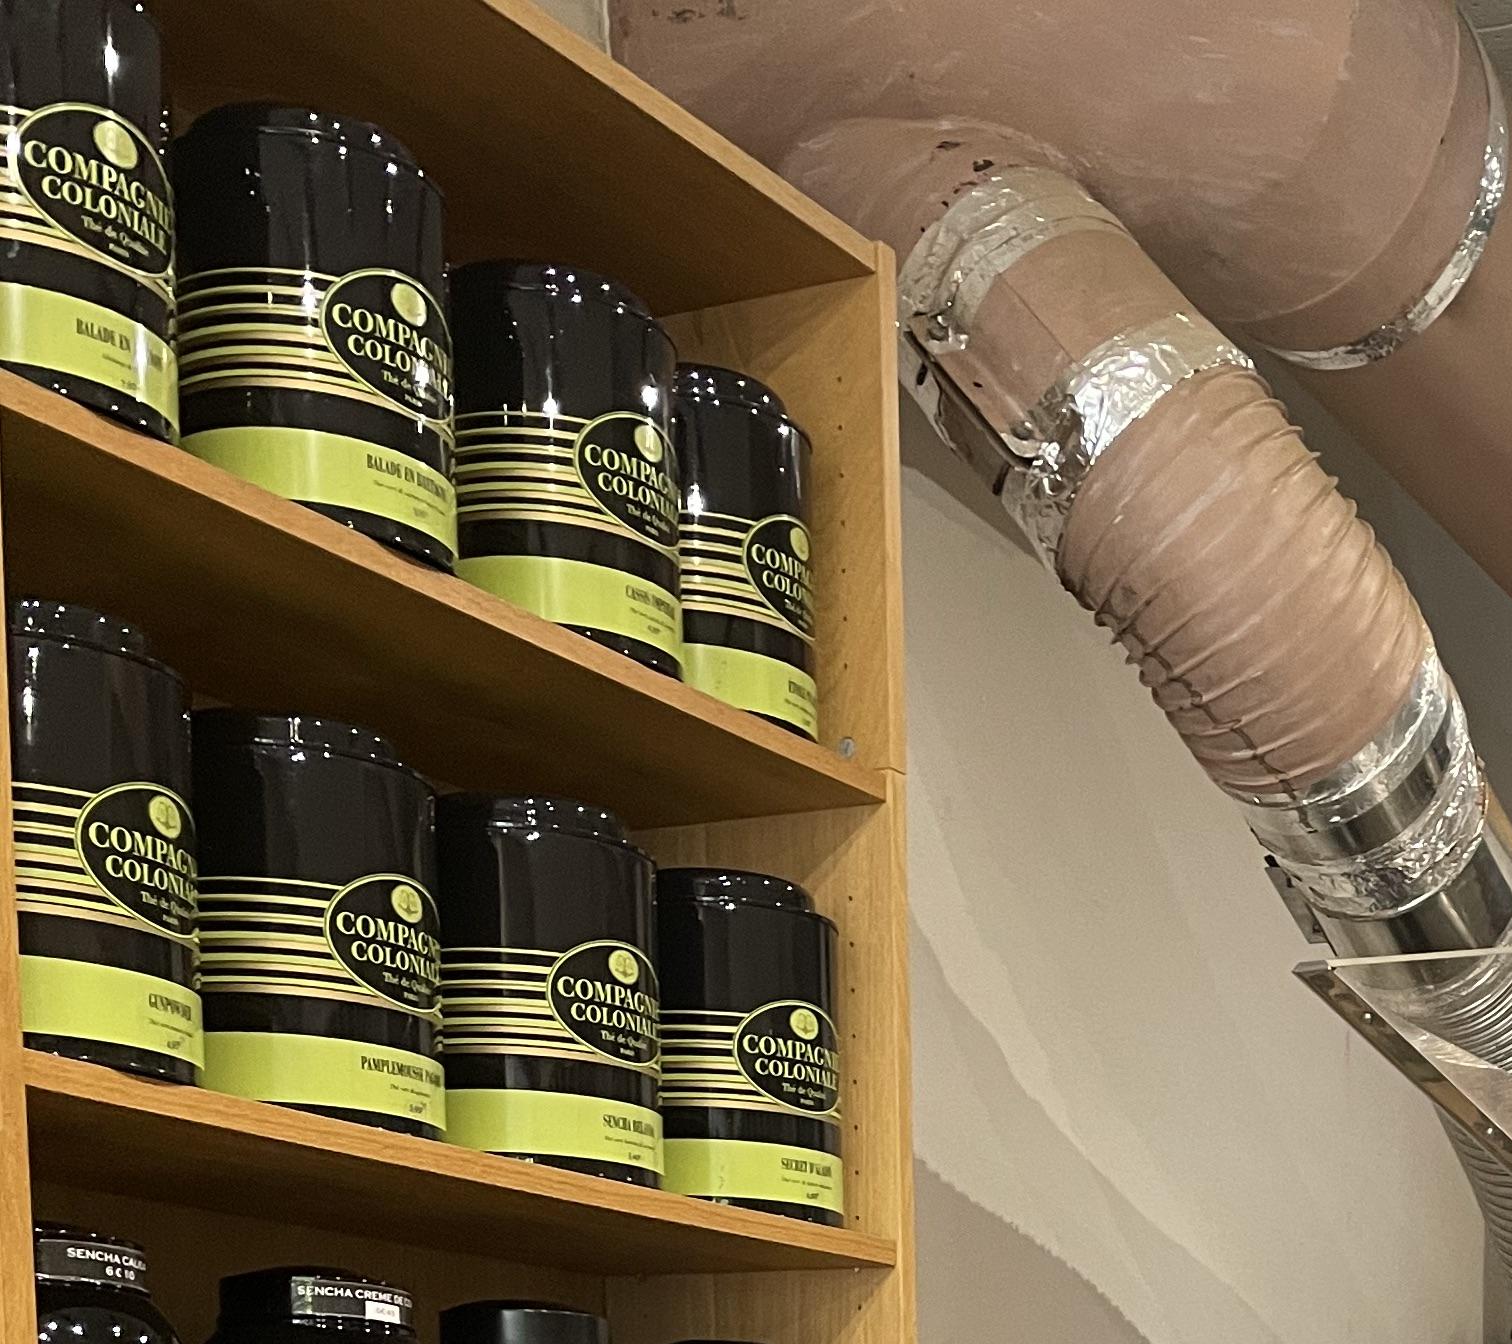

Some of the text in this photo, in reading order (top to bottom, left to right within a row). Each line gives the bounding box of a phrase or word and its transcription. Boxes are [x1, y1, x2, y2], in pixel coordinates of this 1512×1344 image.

[332, 303, 449, 376] COMPAGNI
[367, 453, 402, 479] BALADE
[66, 1247, 121, 1264] SENCHA
[297, 1285, 353, 1298] SENCHA
[355, 1289, 392, 1303] CREME
